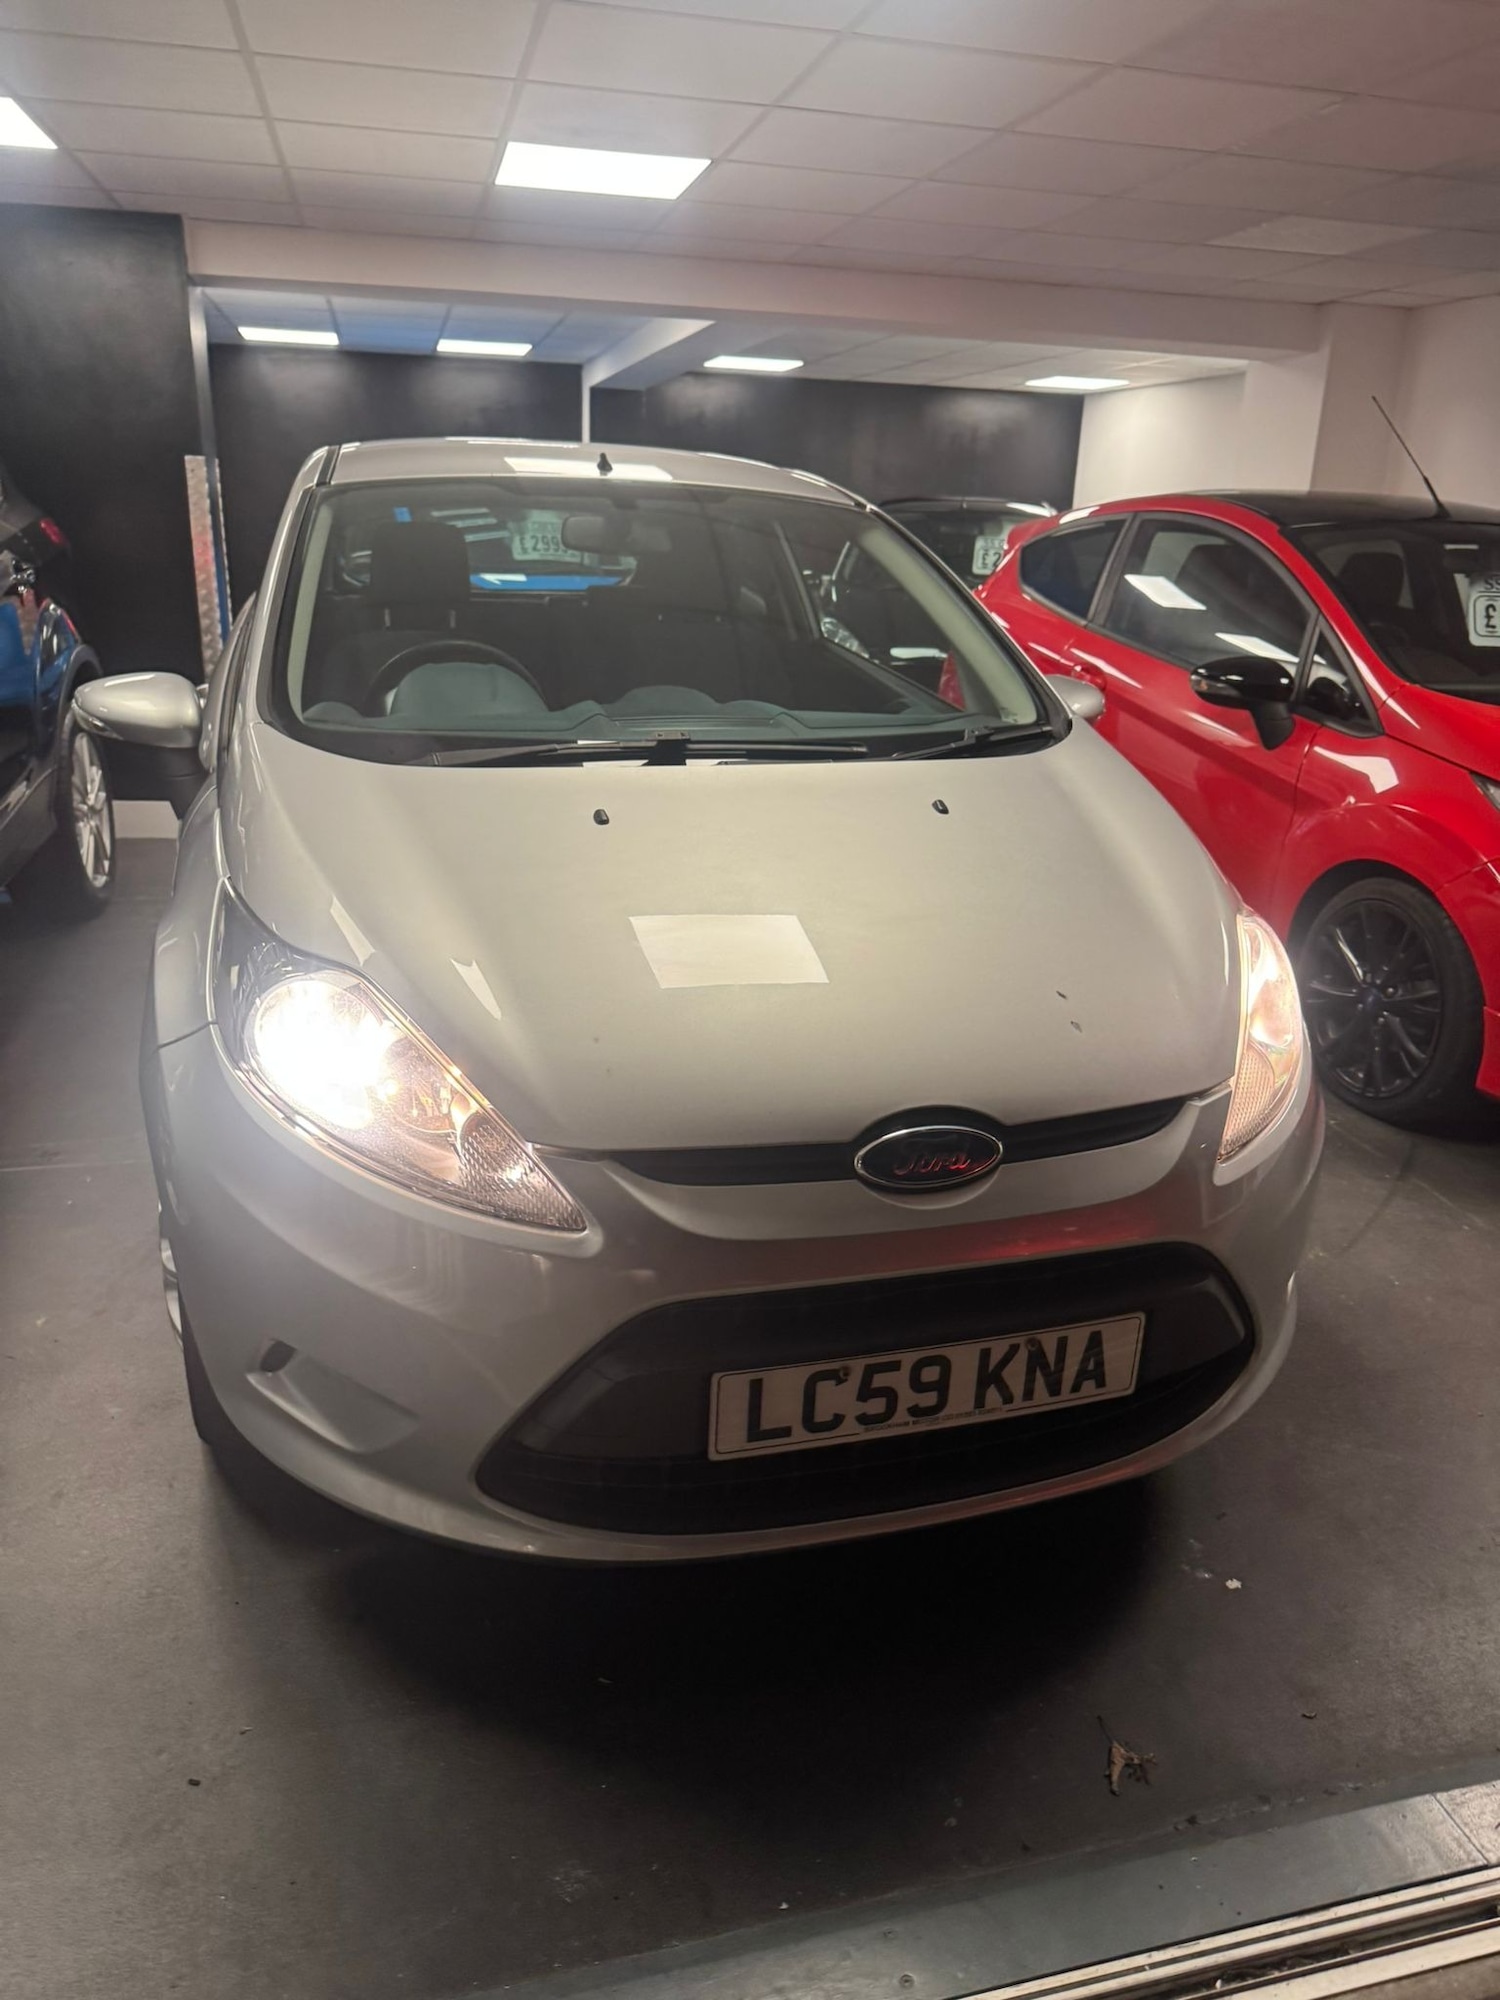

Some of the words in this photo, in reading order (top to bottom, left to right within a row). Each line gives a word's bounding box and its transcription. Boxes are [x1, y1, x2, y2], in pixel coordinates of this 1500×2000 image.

[519, 534, 569, 554] £299
[746, 1354, 952, 1443] LC59
[973, 1330, 1107, 1409] KNA
